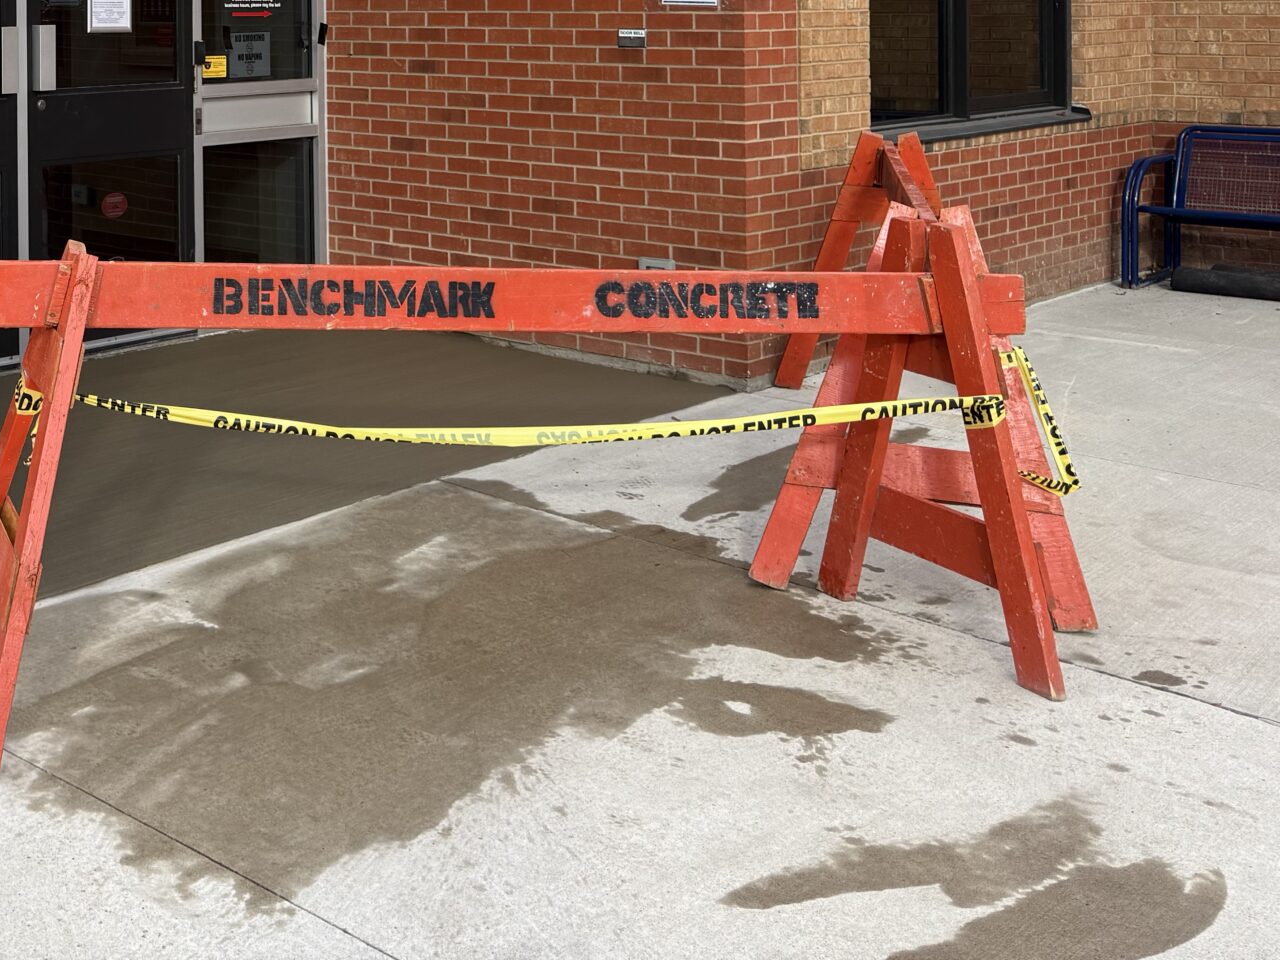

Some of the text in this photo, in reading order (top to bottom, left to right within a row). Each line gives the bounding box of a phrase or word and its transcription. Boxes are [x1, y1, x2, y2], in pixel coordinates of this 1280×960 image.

[235, 34, 265, 42] NO SMOKING
[238, 53, 244, 61] NO
[212, 277, 820, 319] BENCHMARK CONCRETE
